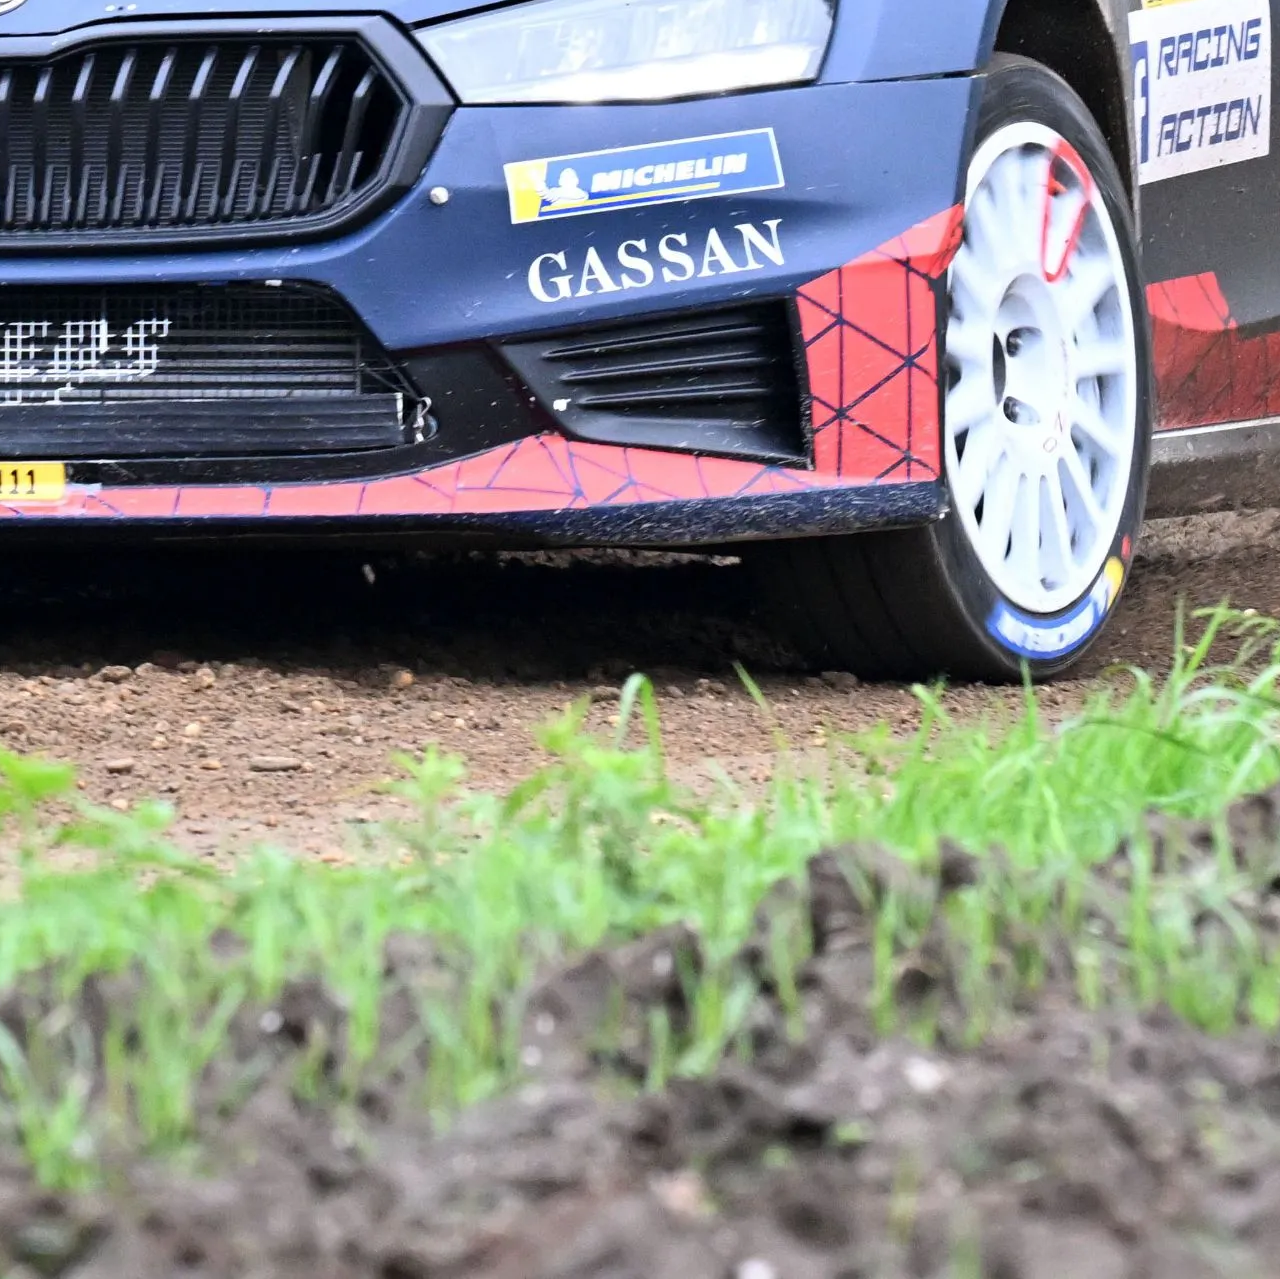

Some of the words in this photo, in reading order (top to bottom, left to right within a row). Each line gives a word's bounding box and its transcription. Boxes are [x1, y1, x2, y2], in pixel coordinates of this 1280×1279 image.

[1156, 17, 1262, 80] RACING
[1156, 94, 1262, 157] ACTION
[590, 151, 749, 194] MICHELIN
[527, 218, 786, 303] GASSAN
